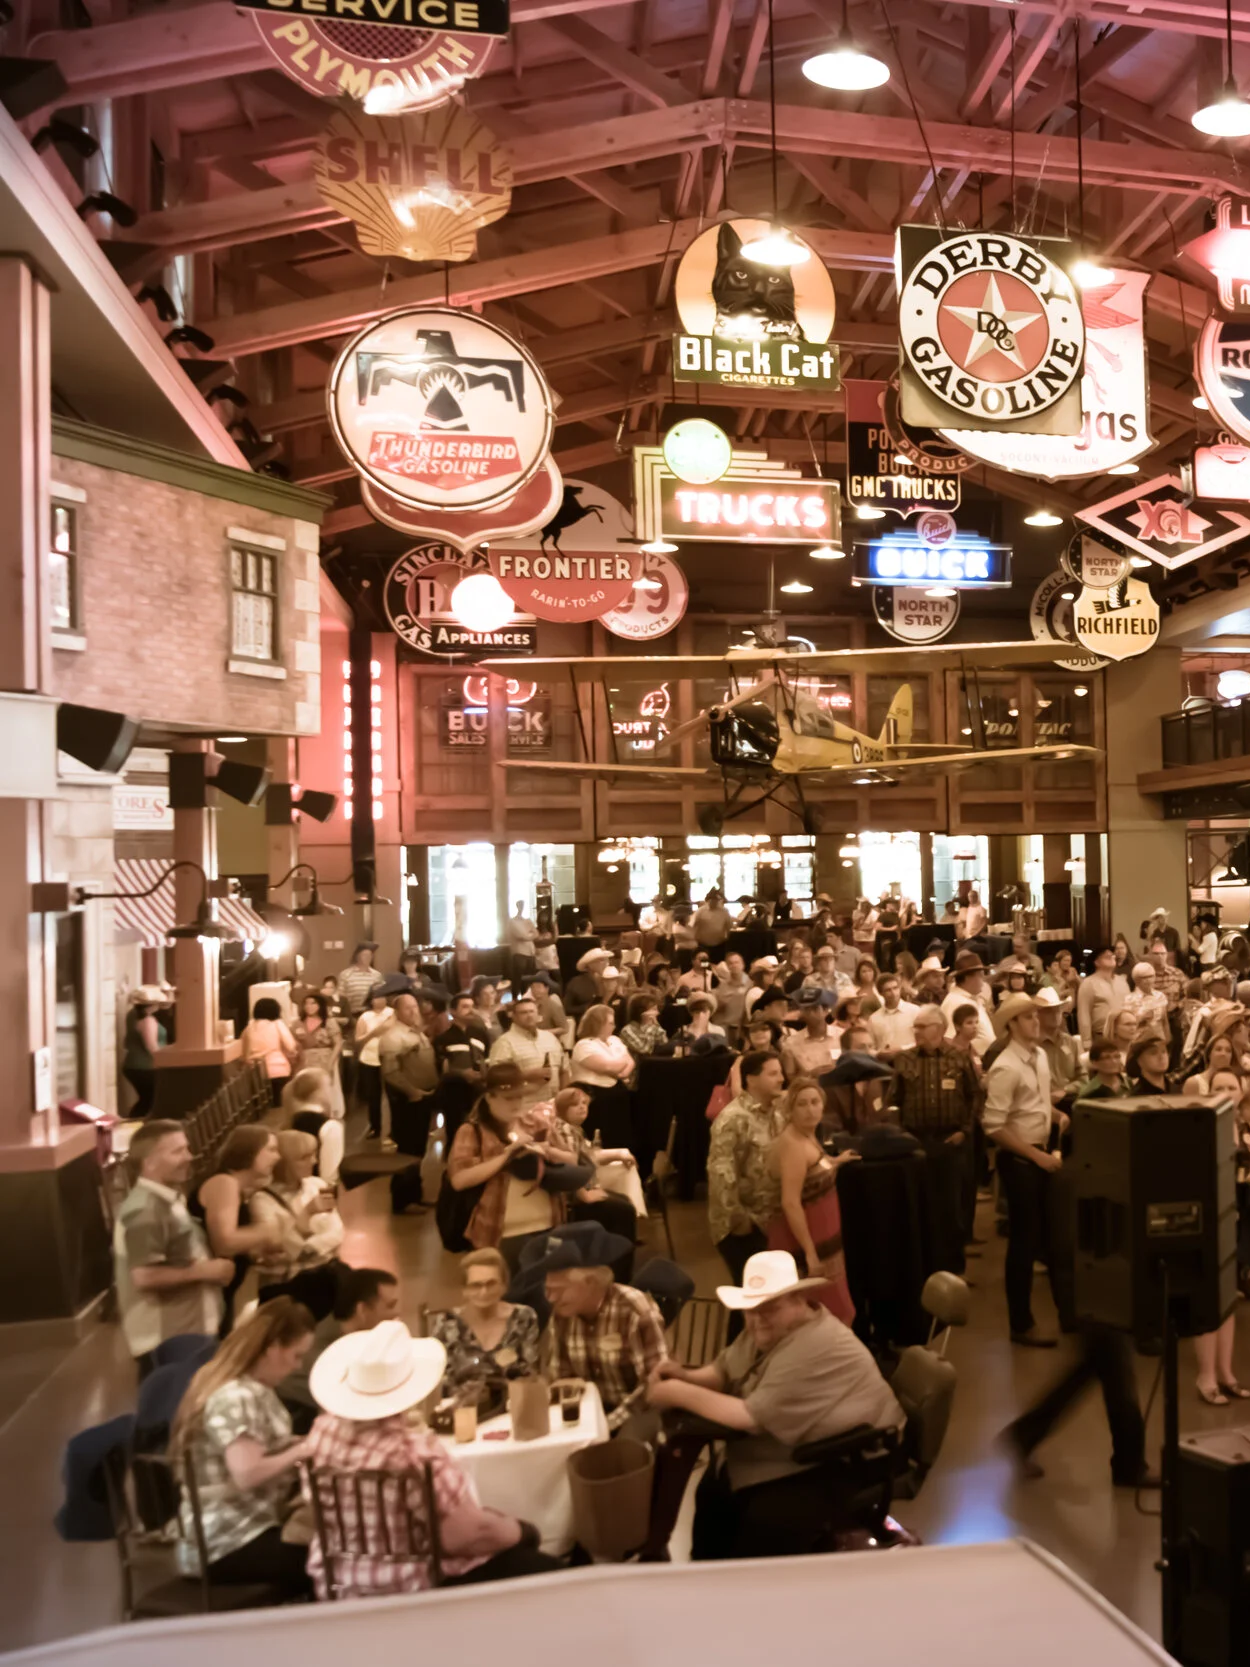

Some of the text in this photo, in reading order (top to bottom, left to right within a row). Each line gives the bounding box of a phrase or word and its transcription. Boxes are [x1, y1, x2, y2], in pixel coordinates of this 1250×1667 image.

[272, 19, 476, 101] PLYMOUTH
[326, 136, 505, 196] SHELL
[913, 238, 1073, 306] DERBY
[679, 336, 835, 379] Black Cat
[721, 373, 795, 386] CIGARETTES
[911, 337, 1080, 416] GASOLINE
[373, 433, 517, 460] THUNDERBIRD
[403, 458, 491, 476] GASOLINE
[851, 475, 956, 501] GMC TRUCKS
[675, 491, 827, 528] TRUCKS
[499, 555, 633, 580] FRONTIER
[876, 547, 990, 580] BUICK
[1090, 568, 1119, 577] STAR
[900, 599, 949, 613] NORTH
[394, 614, 432, 649] GAS
[905, 615, 943, 627] STAR
[1078, 617, 1158, 635] RICHFIELD
[436, 627, 531, 645] APPLIANCES
[448, 711, 544, 732] BUCK
